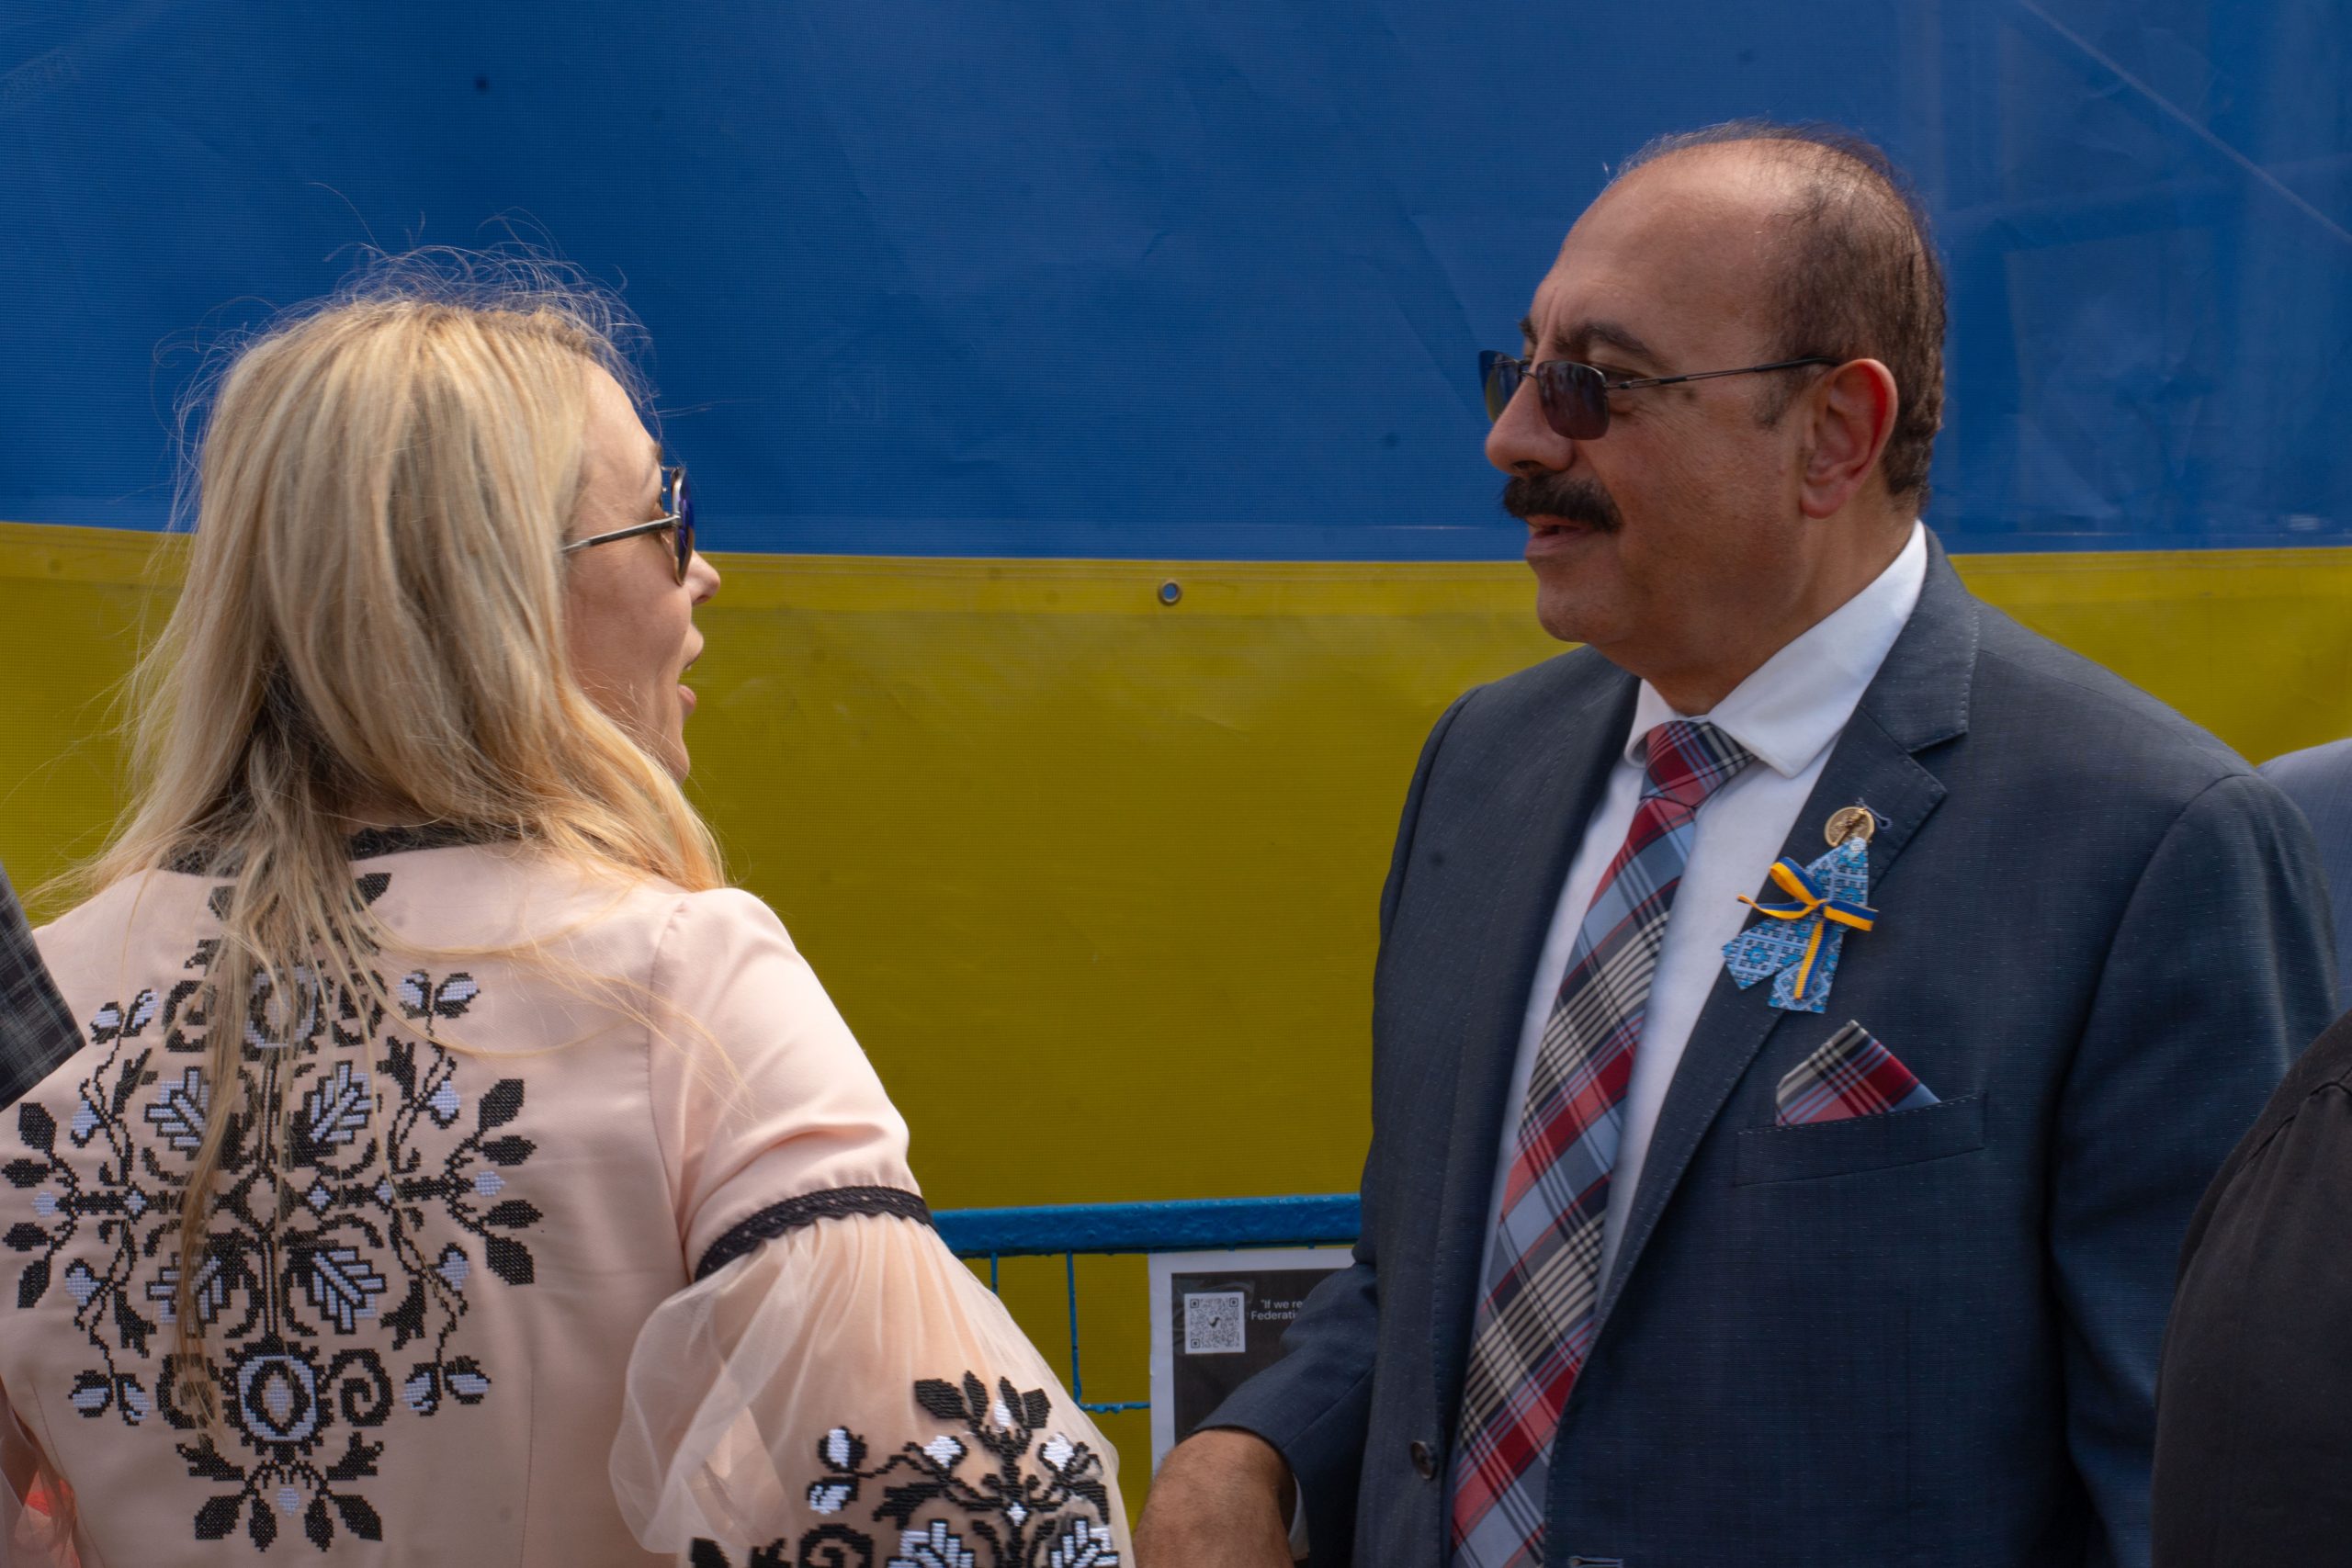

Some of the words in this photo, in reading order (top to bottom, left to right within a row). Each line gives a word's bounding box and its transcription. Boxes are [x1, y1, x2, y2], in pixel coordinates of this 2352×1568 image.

[1273, 1301, 1290, 1309] we
[1291, 1300, 1304, 1309] re
[1250, 1309, 1296, 1321] Federati
